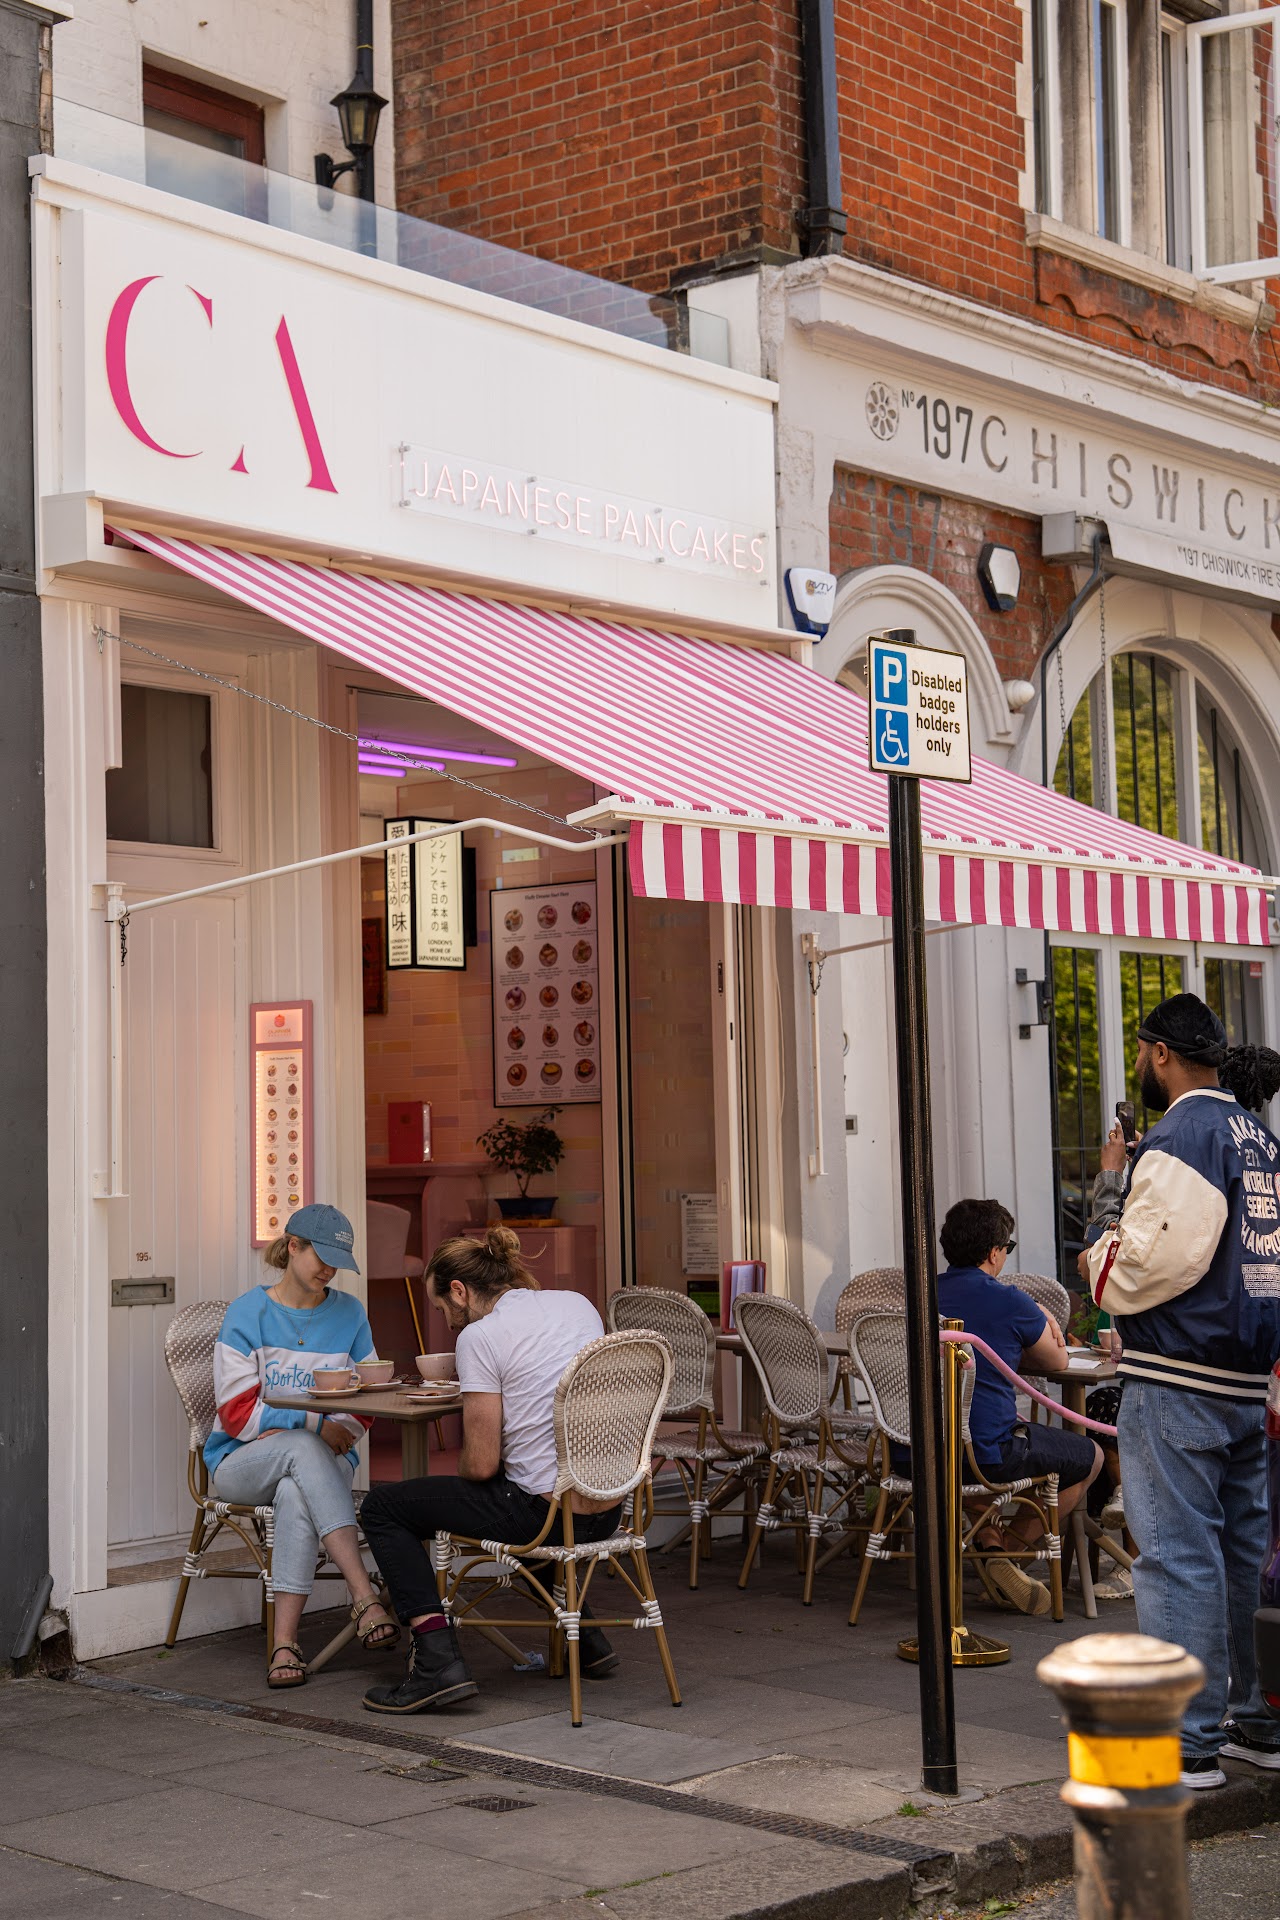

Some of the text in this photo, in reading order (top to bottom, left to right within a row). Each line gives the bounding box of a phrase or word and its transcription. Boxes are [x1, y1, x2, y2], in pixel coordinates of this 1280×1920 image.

[105, 275, 339, 494] CA
[916, 394, 973, 464] 197
[415, 460, 765, 573] JAPANESE PANCAKES
[861, 478, 942, 575] 197
[1201, 552, 1250, 580] CHISWICK
[1251, 565, 1274, 587] FIRE
[882, 655, 903, 699] P
[911, 669, 962, 693] Disabled
[920, 692, 955, 714] badge
[916, 712, 961, 734] holders
[926, 738, 952, 756] only
[439, 826, 449, 932] ンケーキの本場
[391, 911, 407, 932] 味
[1227, 1114, 1278, 1162] ANKEES
[1242, 1170, 1274, 1195] WORLD
[1246, 1195, 1278, 1220] SERIES
[1241, 1214, 1280, 1257] HAMPIO
